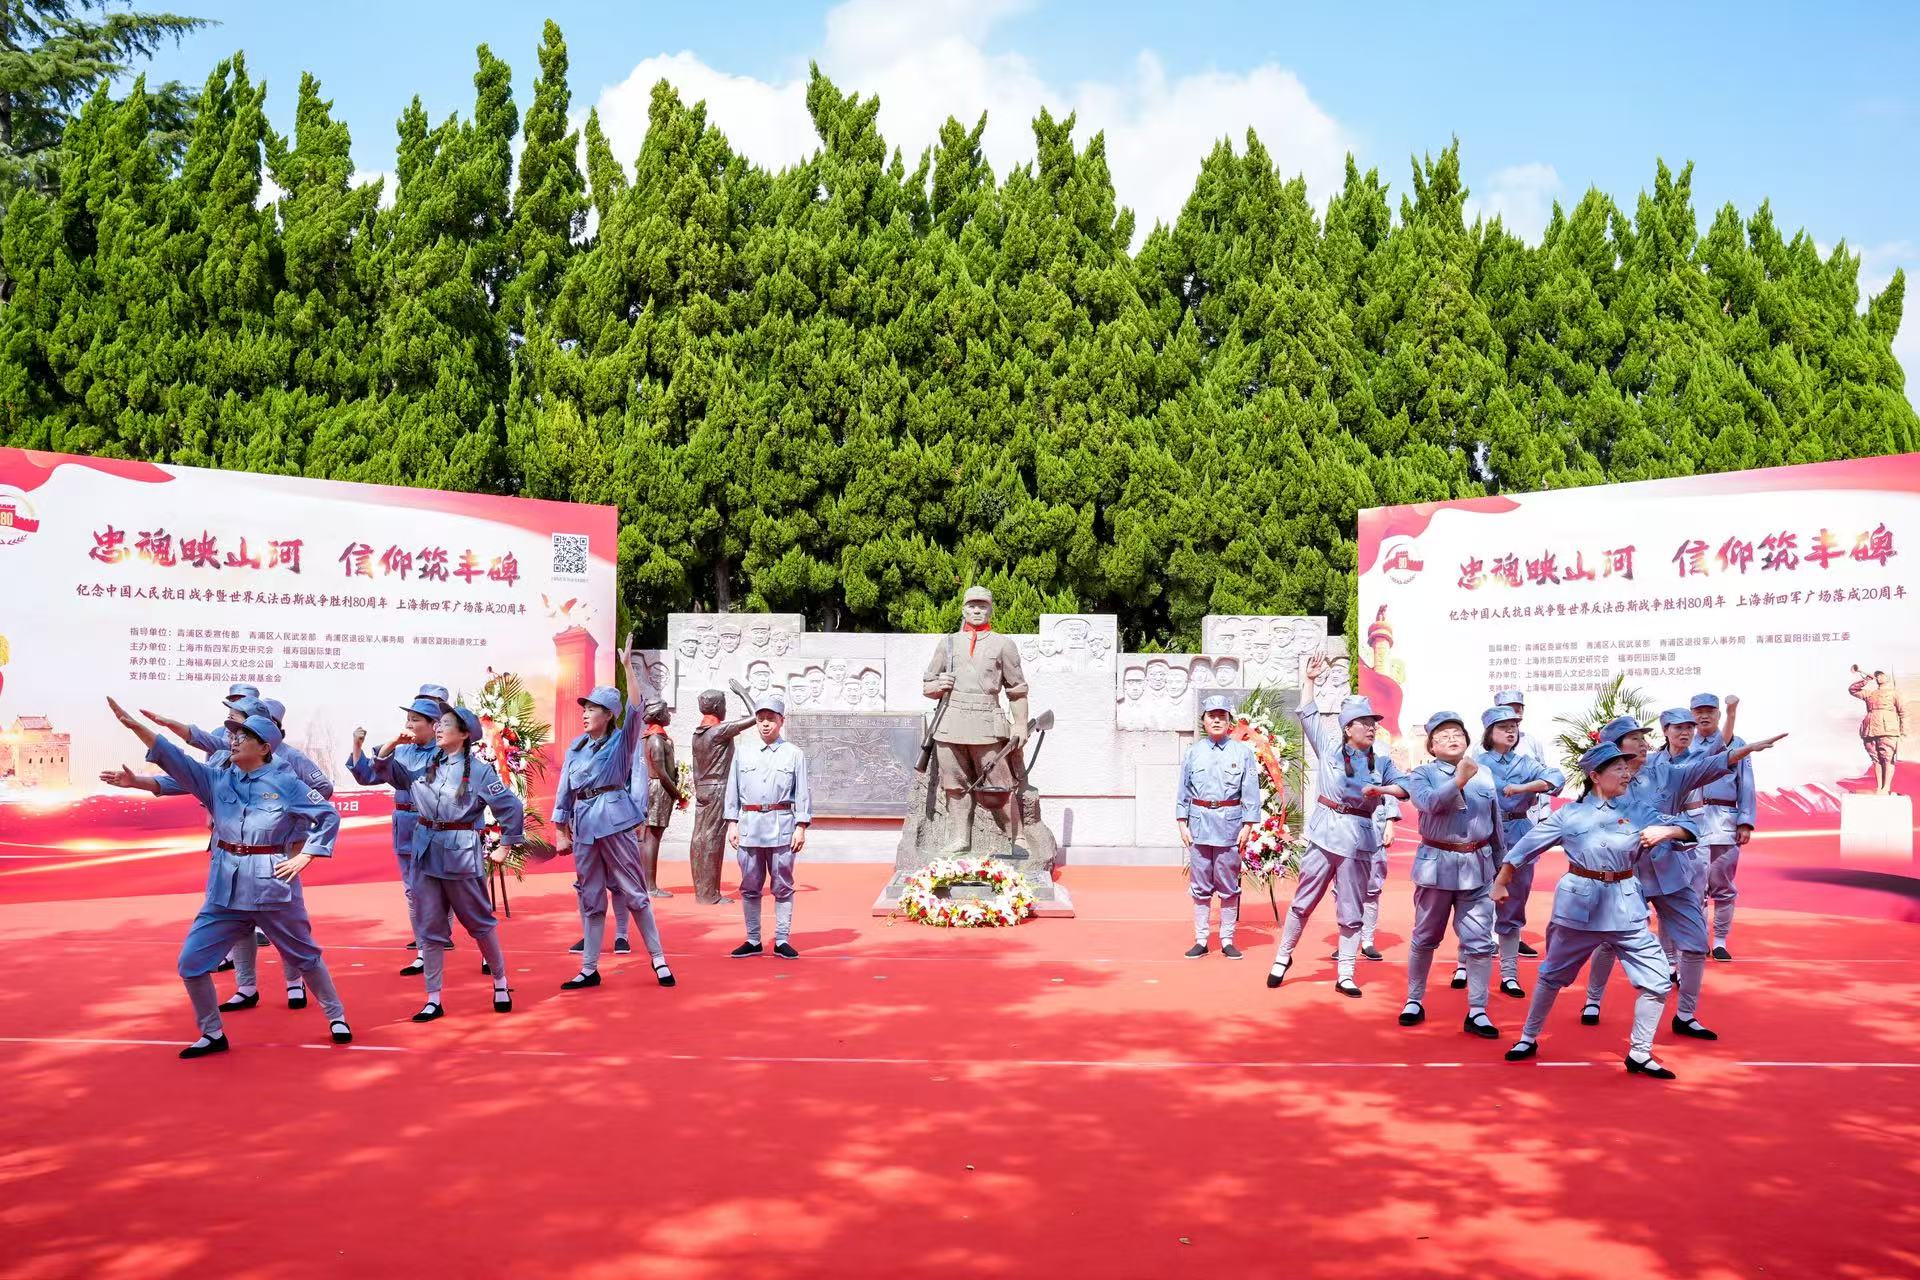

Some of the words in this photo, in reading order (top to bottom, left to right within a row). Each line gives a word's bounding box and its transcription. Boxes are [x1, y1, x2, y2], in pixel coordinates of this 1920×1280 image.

[0, 511, 13, 526] 80
[89, 524, 304, 574] 忠魂映山河
[338, 542, 521, 587] 信仰筑丰碑
[1457, 544, 1636, 590] 忠魂映山河
[1672, 523, 1898, 577] 信仰筑丰碑
[396, 598, 527, 615] 上海新四军广场落成20周年
[1736, 585, 1907, 607] 上海新四军广场落成20周年
